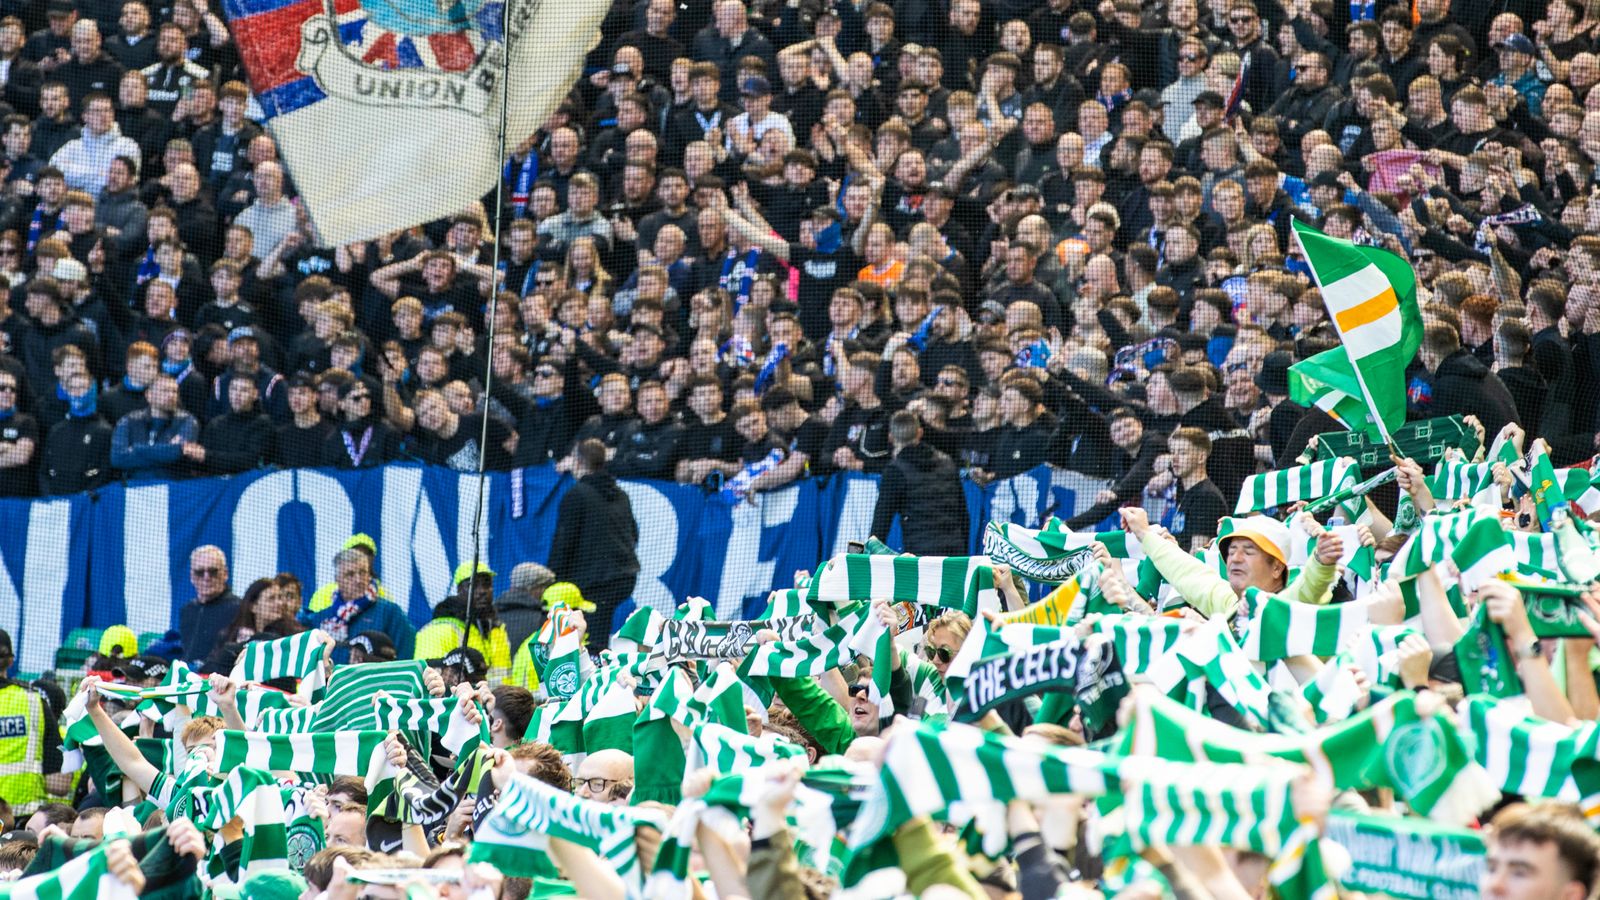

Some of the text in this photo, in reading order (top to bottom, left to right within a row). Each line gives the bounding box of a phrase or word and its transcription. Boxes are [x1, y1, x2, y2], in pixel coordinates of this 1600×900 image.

[354, 72, 466, 105] UNION
[963, 638, 1081, 714] THE CELTS
